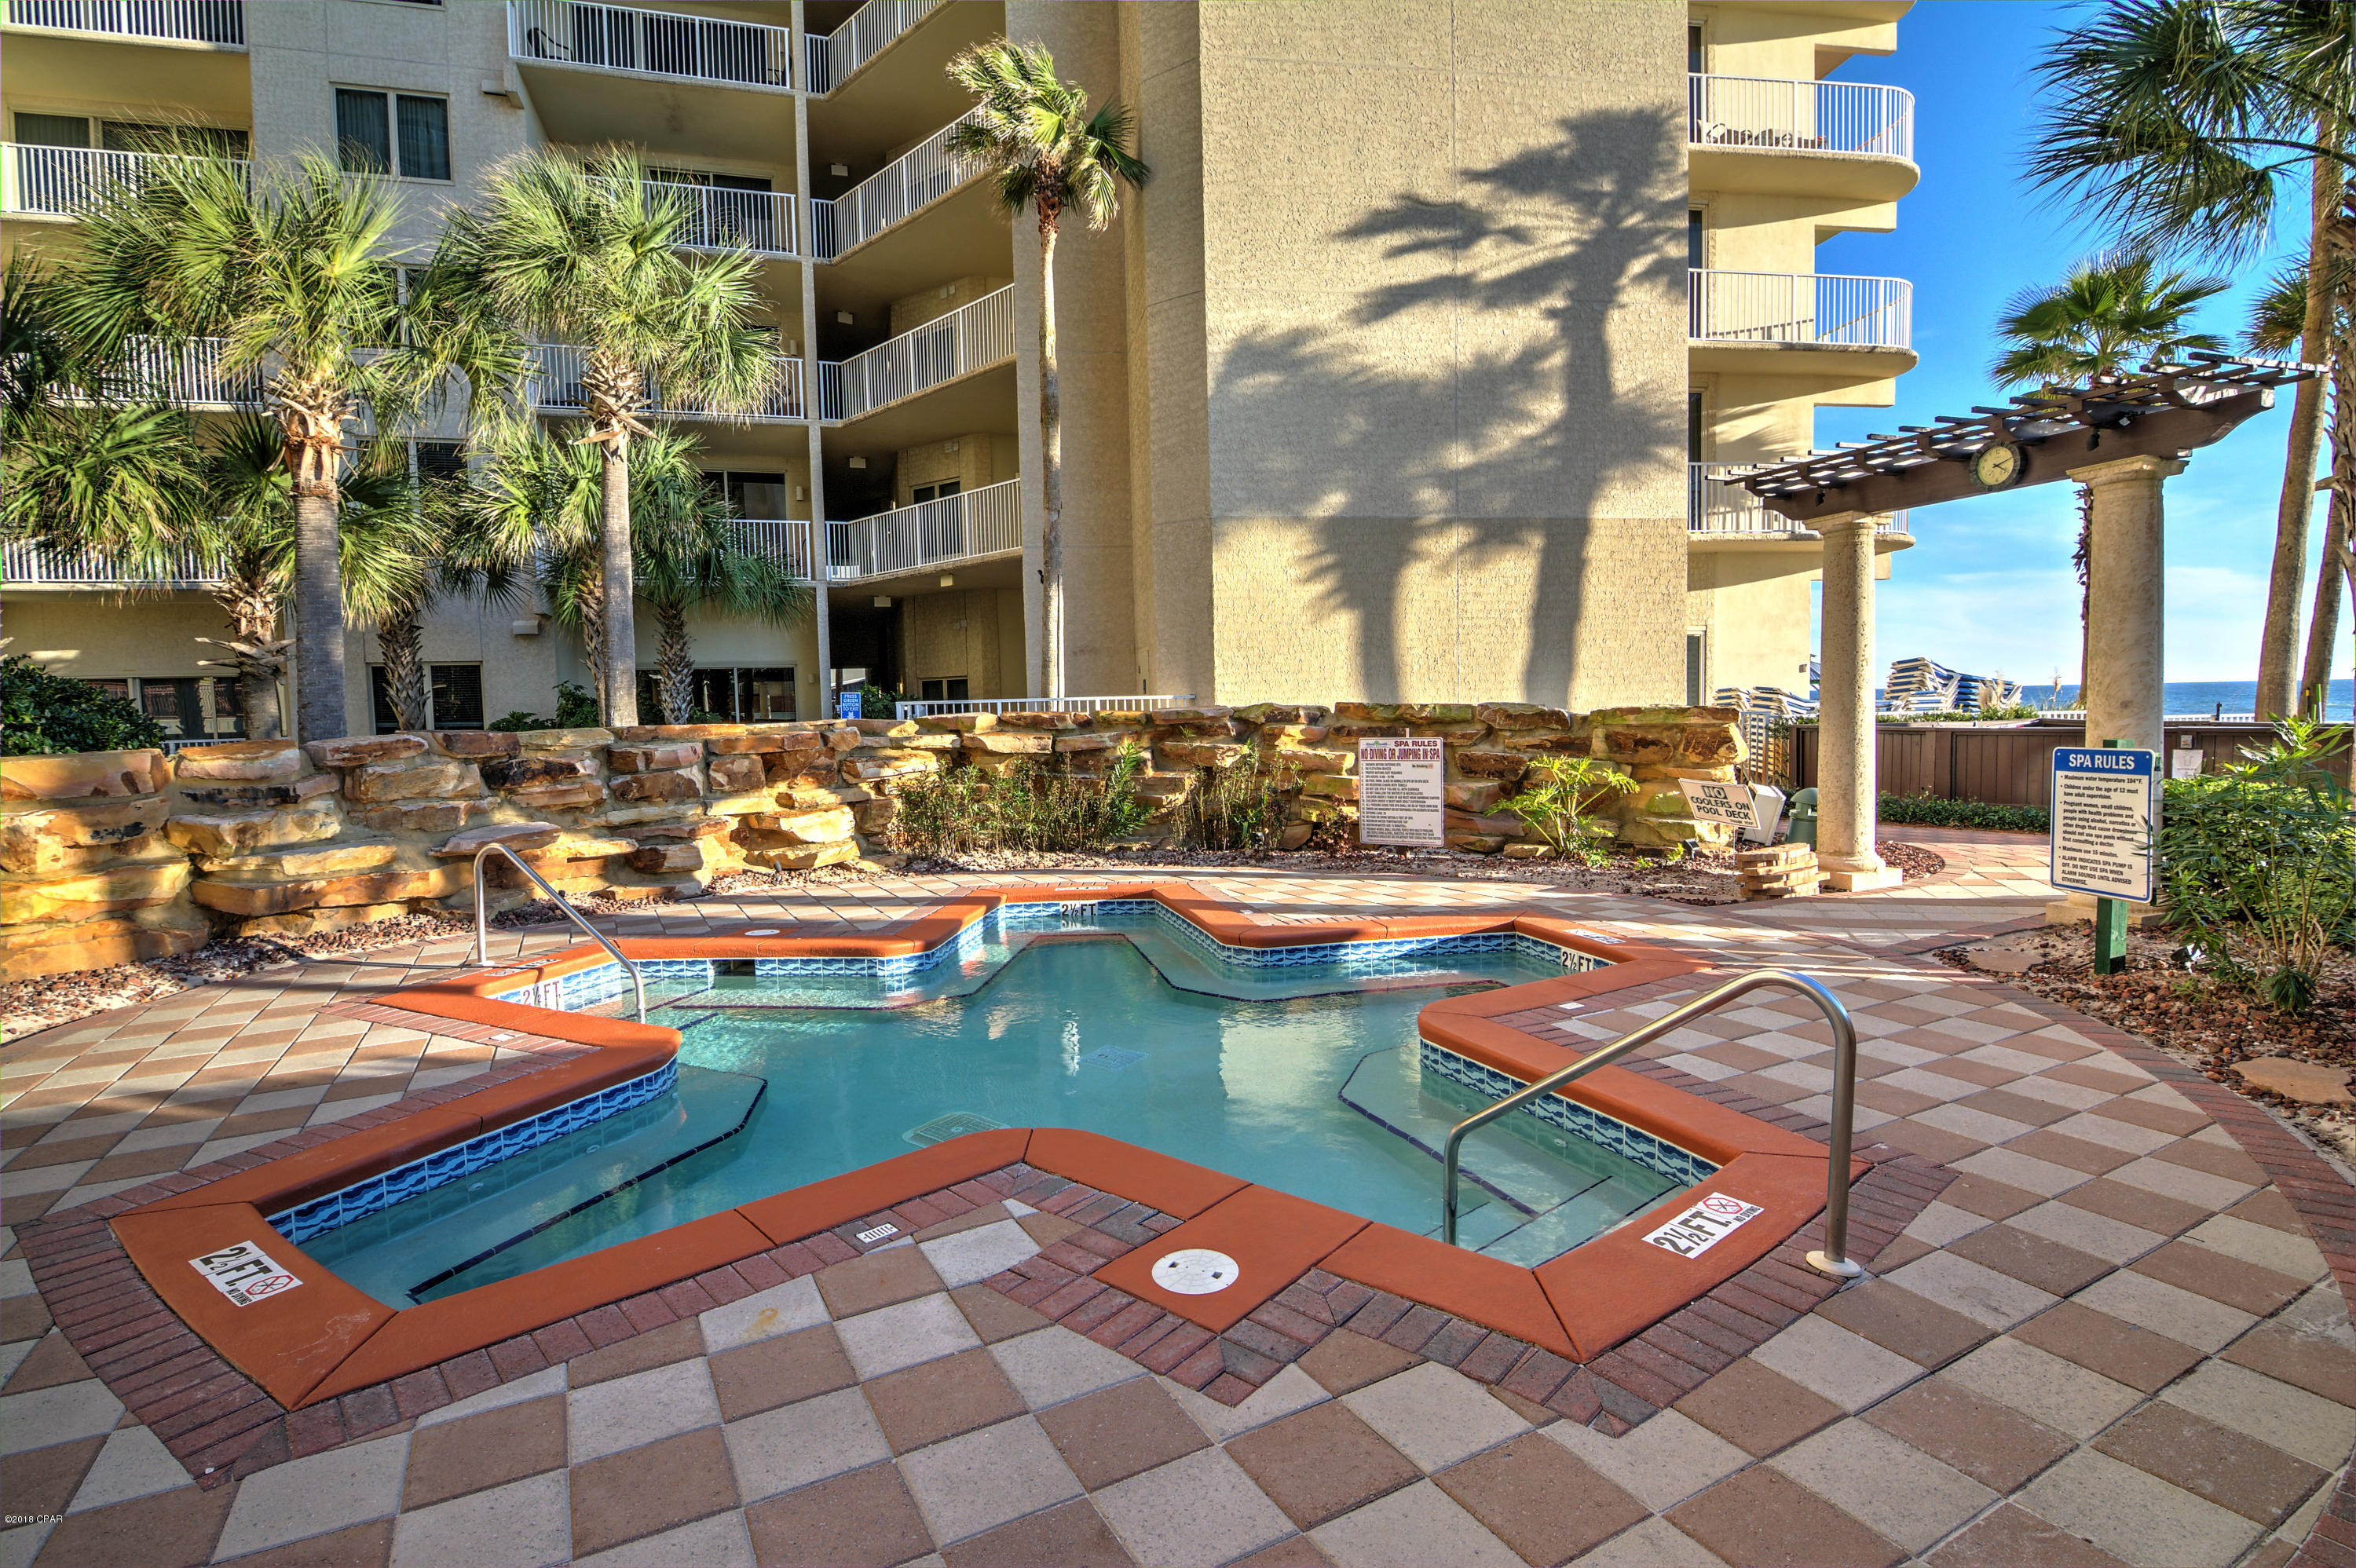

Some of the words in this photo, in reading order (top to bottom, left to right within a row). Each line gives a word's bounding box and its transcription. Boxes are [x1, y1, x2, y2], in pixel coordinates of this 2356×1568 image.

[1361, 748, 1368, 759] NO
[1370, 748, 1386, 759] DIVING
[1389, 748, 1396, 759] OR
[1397, 748, 1421, 760] JUMPING
[1423, 748, 1428, 760] IN
[1430, 748, 1440, 760] SPA
[2069, 753, 2092, 767] SPA
[2094, 754, 2135, 769] RULES
[1703, 786, 1726, 799] NO
[1690, 796, 1732, 809] COOLERS
[1735, 802, 1750, 811] ON
[1696, 805, 1722, 816] POOL
[1726, 810, 1751, 820] DECK
[2078, 857, 2101, 865] INDICATES
[1080, 904, 1096, 916] FT.
[1740, 1205, 1760, 1217] DIVING
[1677, 1211, 1733, 1236] FT.
[215, 1259, 273, 1287] FT.
